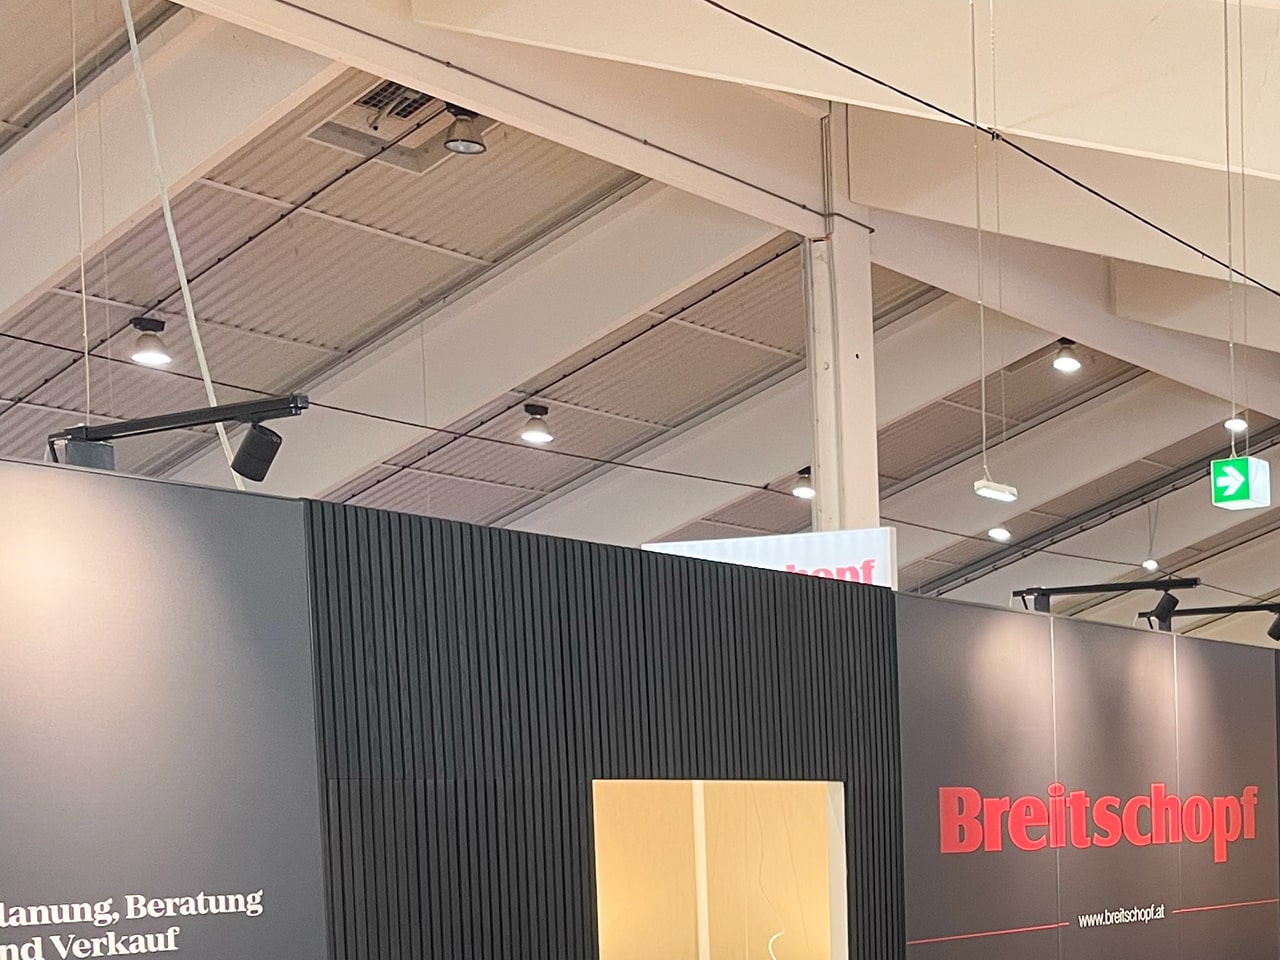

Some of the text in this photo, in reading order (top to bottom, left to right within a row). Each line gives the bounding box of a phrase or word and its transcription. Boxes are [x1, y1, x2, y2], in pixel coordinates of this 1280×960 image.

[939, 782, 1259, 863] Breitschopf
[125, 889, 263, 920] Beratung
[1078, 904, 1165, 928] www.breitschopf.at
[49, 926, 180, 960] Verkauf
